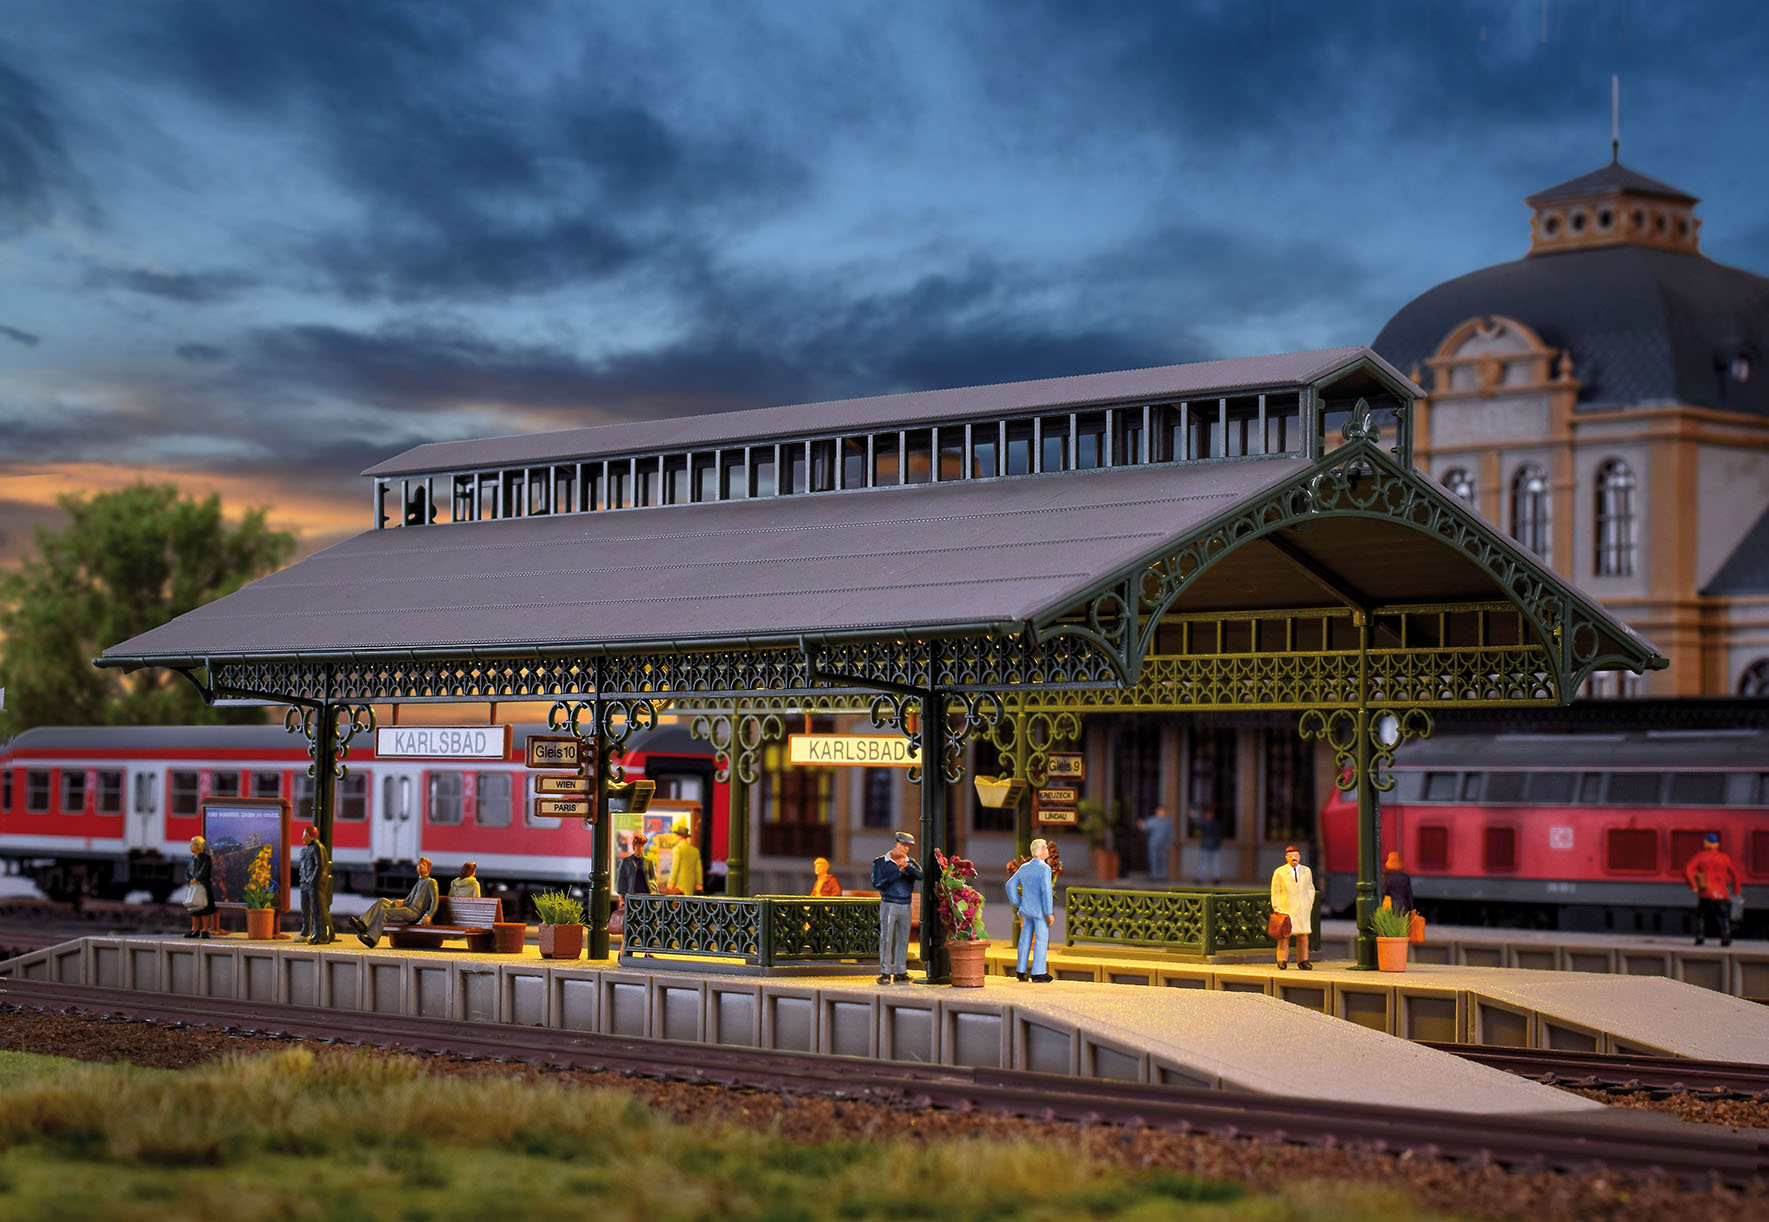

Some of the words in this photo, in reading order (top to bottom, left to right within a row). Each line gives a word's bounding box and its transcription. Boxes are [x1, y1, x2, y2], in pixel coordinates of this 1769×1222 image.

[394, 731, 486, 754] KARLSBAD
[809, 740, 906, 761] KARLSBAD
[1073, 760, 1080, 772] 9
[555, 780, 577, 789] WIEN
[553, 803, 577, 812] PARIS
[1044, 812, 1068, 820] LINDAU
